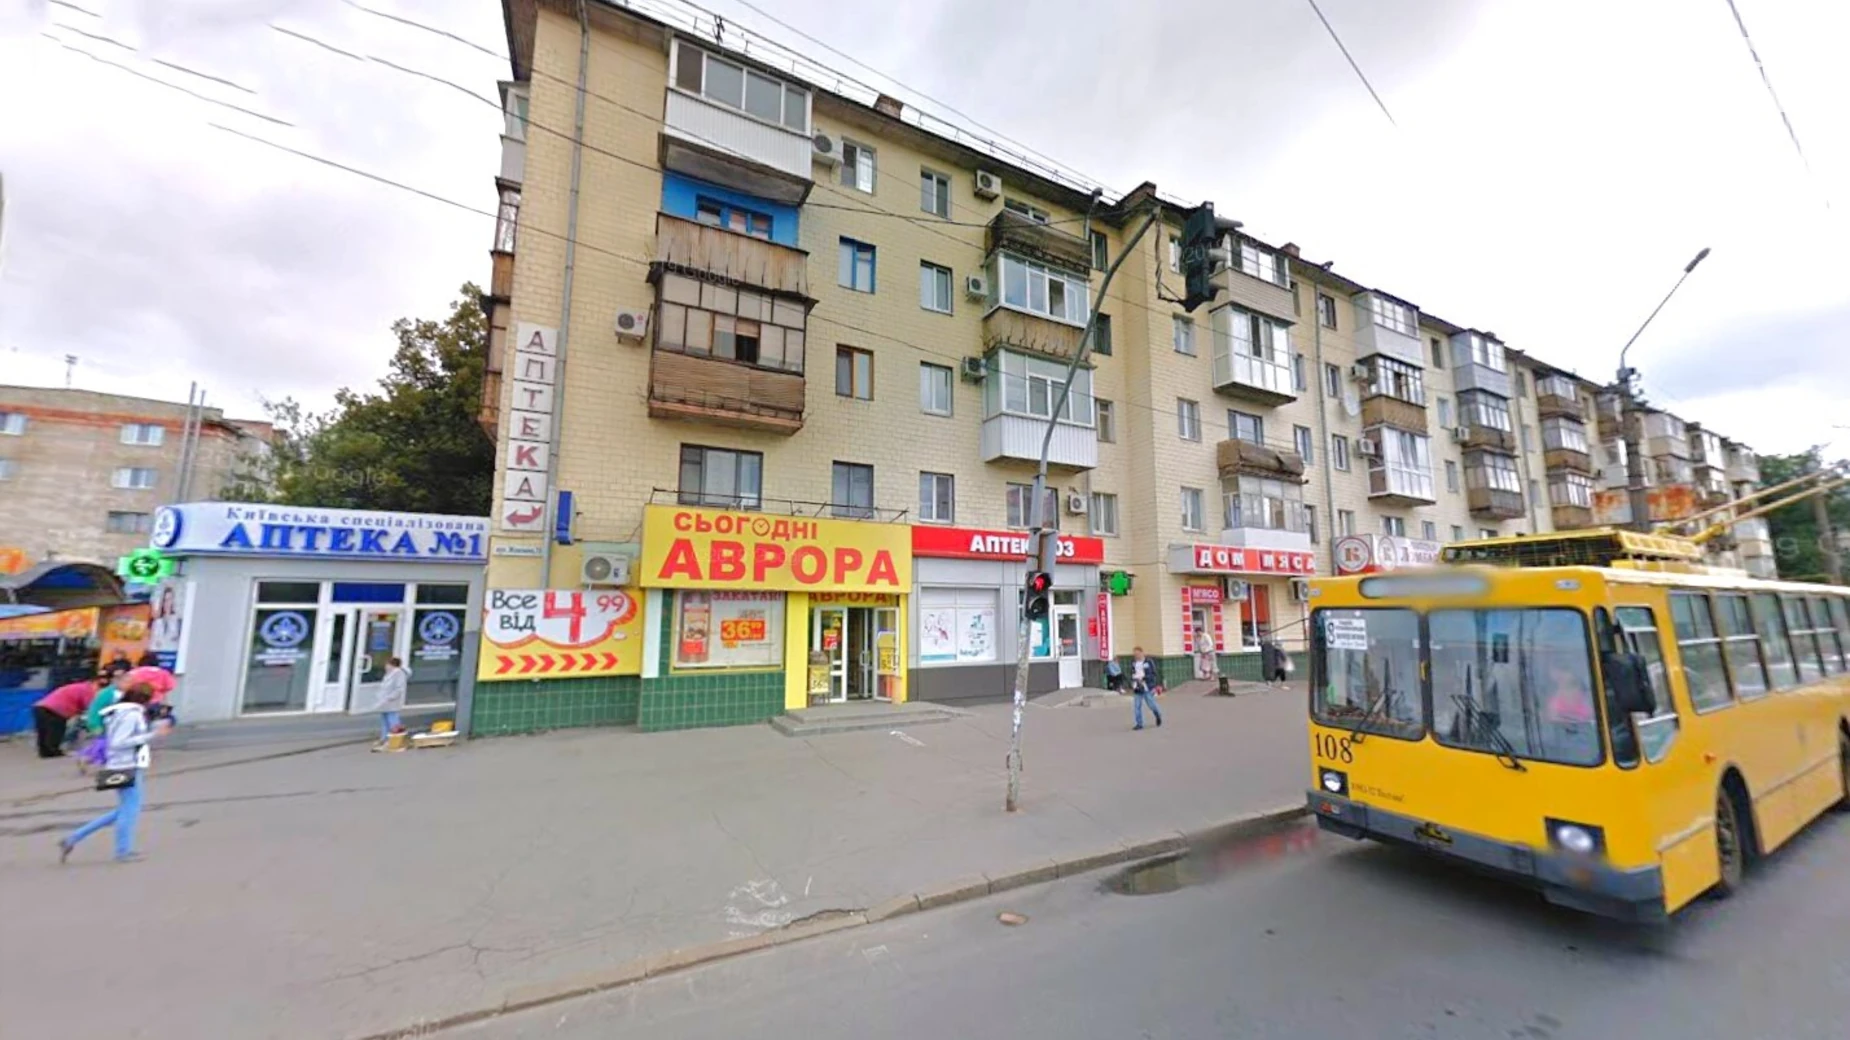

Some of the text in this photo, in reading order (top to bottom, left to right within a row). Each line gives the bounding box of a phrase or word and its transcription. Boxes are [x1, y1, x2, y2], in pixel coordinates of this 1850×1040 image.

[515, 330, 546, 497] АПТЕКА
[219, 522, 483, 556] АПТЕКА №1
[969, 534, 1030, 554] АПТЕК
[657, 537, 900, 586] АВРОРА
[1200, 550, 1244, 567] ДОМ
[492, 589, 538, 610] Все
[500, 612, 536, 632] від
[543, 592, 626, 643] 4 99
[1327, 622, 1336, 645] 8
[1315, 732, 1353, 764] 108
